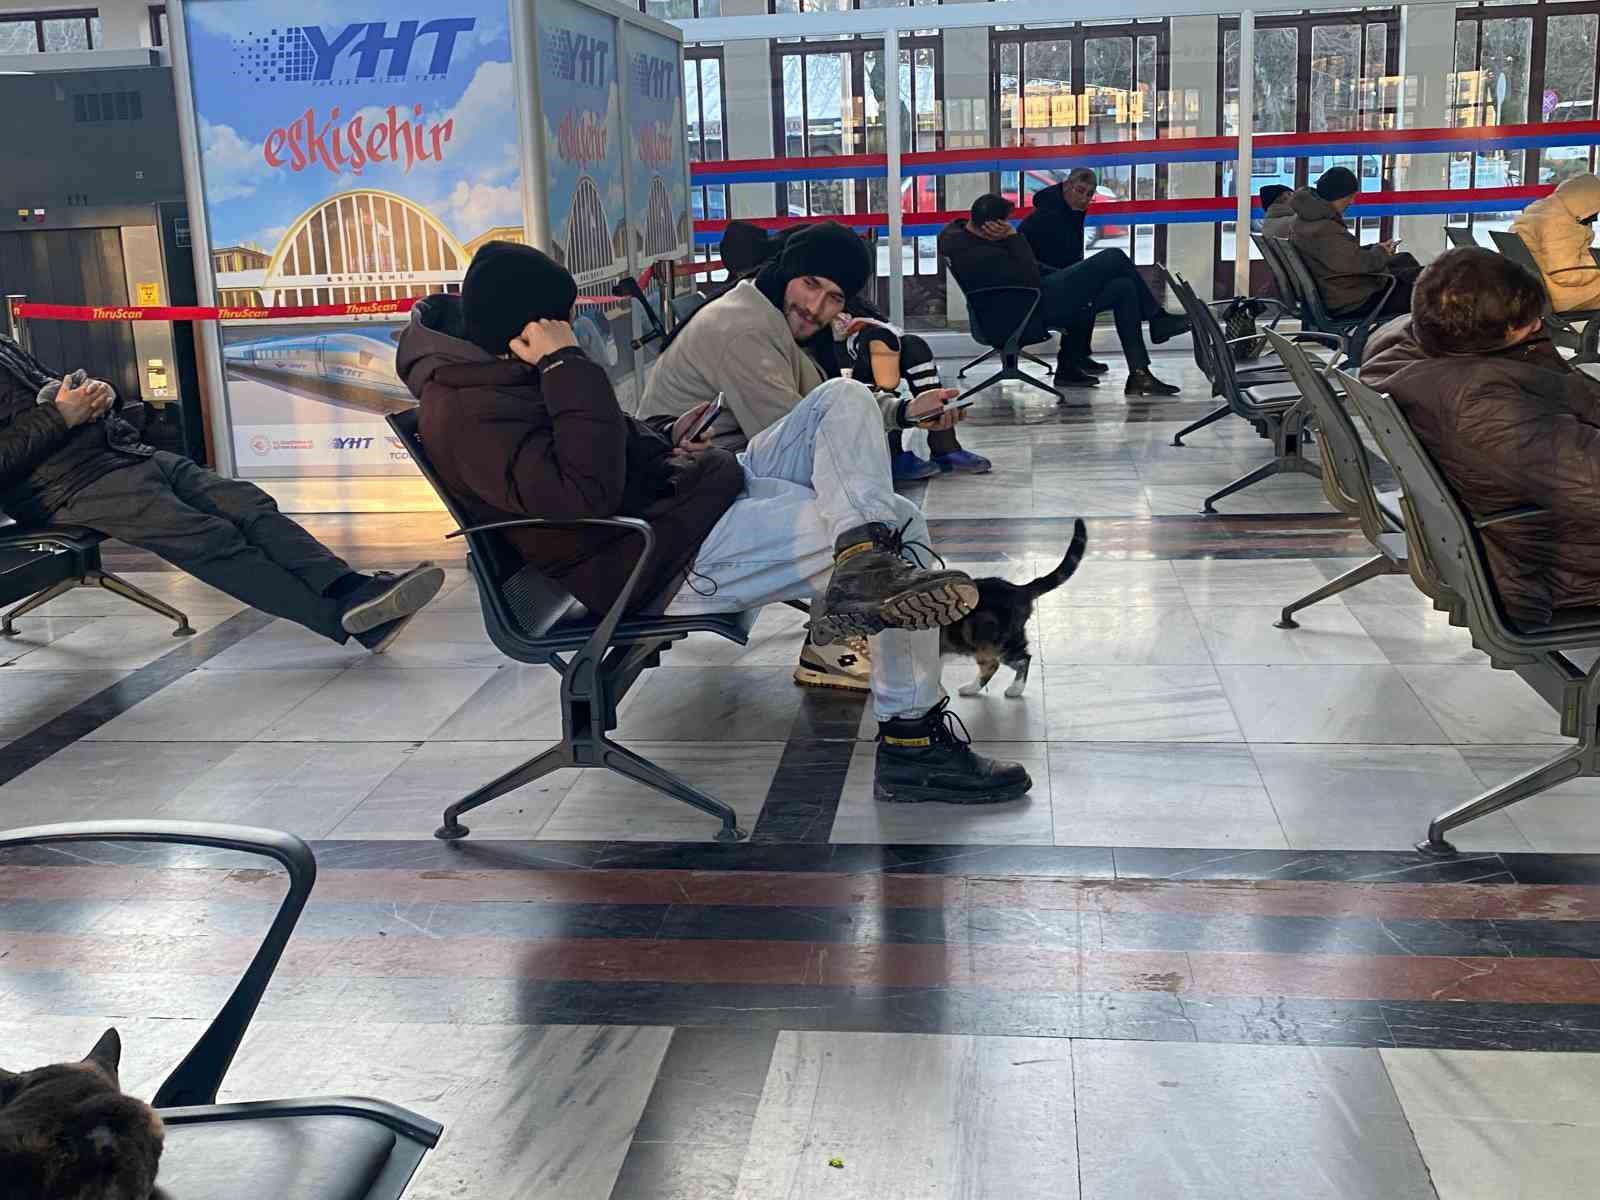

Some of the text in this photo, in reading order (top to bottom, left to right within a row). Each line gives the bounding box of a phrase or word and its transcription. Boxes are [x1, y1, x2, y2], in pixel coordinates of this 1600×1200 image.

[302, 17, 476, 81] YHT
[567, 30, 609, 88] YHT
[644, 55, 674, 99] YHT
[263, 103, 453, 176] eskişehir
[93, 308, 143, 319] ThruScan
[218, 309, 268, 319] ThruScan
[345, 302, 397, 313] ThruScan
[338, 437, 375, 449] YHT
